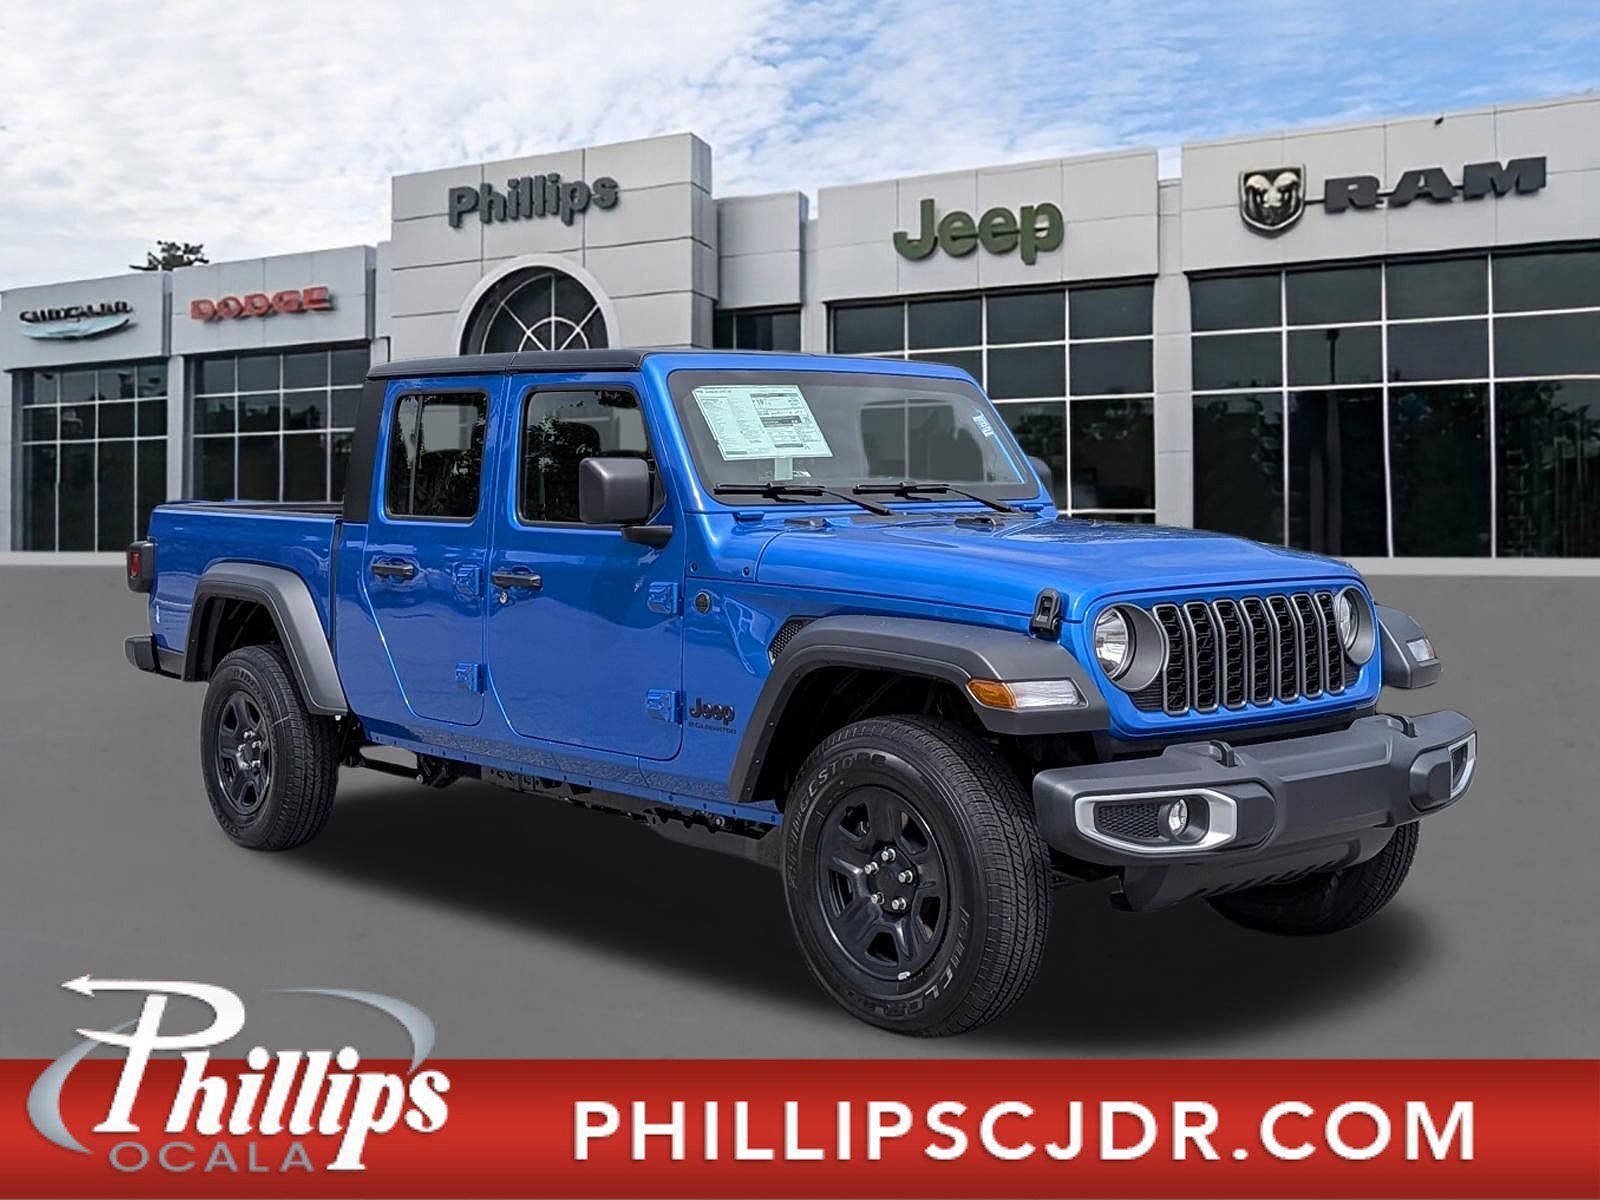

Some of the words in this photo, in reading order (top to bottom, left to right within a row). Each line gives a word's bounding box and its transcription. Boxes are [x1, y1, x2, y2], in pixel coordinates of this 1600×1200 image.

[448, 172, 619, 229] Phillips
[1324, 156, 1547, 214] RAM
[893, 198, 1064, 265] Jeep
[190, 286, 331, 321] DODGE
[689, 697, 735, 725] Jeep
